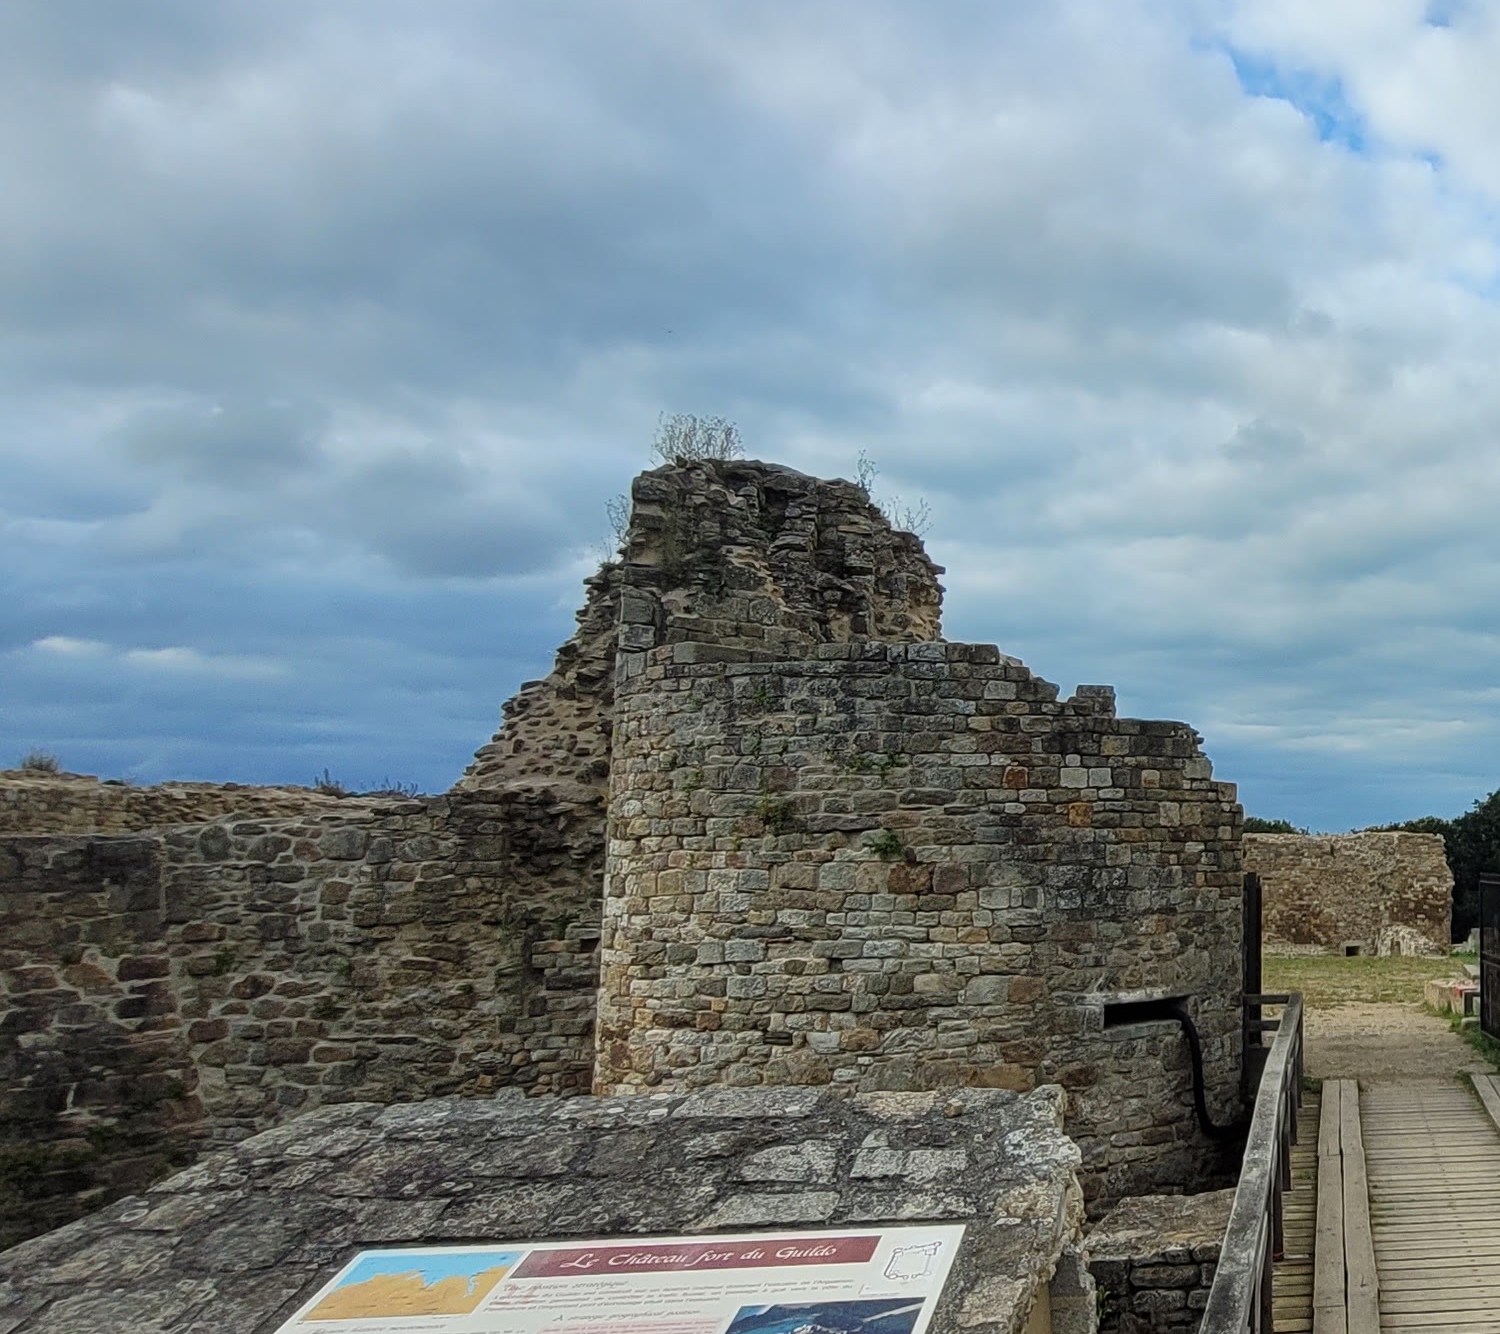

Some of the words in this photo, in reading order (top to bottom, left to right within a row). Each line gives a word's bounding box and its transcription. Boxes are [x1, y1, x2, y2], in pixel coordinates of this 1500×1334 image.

[560, 1253, 599, 1268] Le
[608, 1252, 687, 1266] Château
[685, 1250, 734, 1267] fort
[740, 1247, 763, 1260] du
[775, 1244, 837, 1259] Guildo
